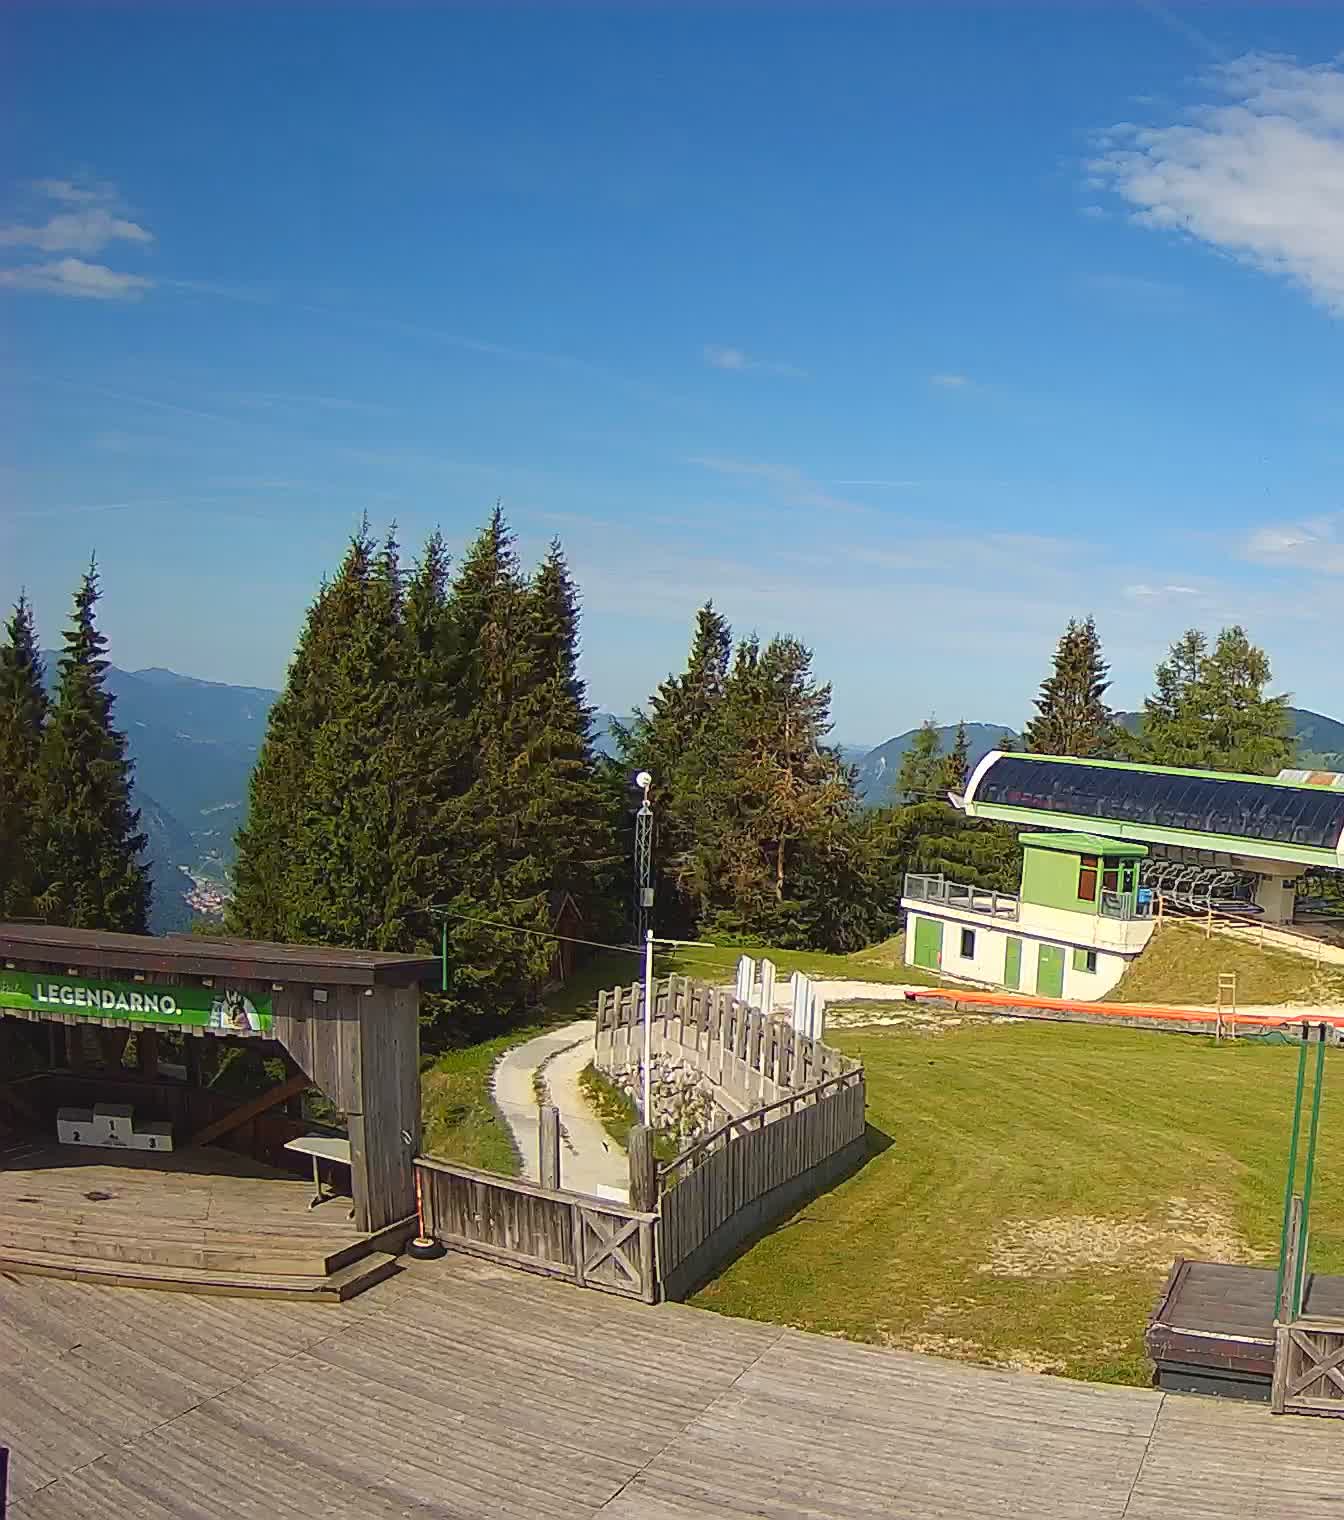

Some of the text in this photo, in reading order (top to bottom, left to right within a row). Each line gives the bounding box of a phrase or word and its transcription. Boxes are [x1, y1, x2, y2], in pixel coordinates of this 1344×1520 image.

[36, 983, 183, 1016] LEGENDARNO.
[109, 1119, 116, 1131] 1
[73, 1131, 81, 1142] 2
[148, 1137, 157, 1149] 3
